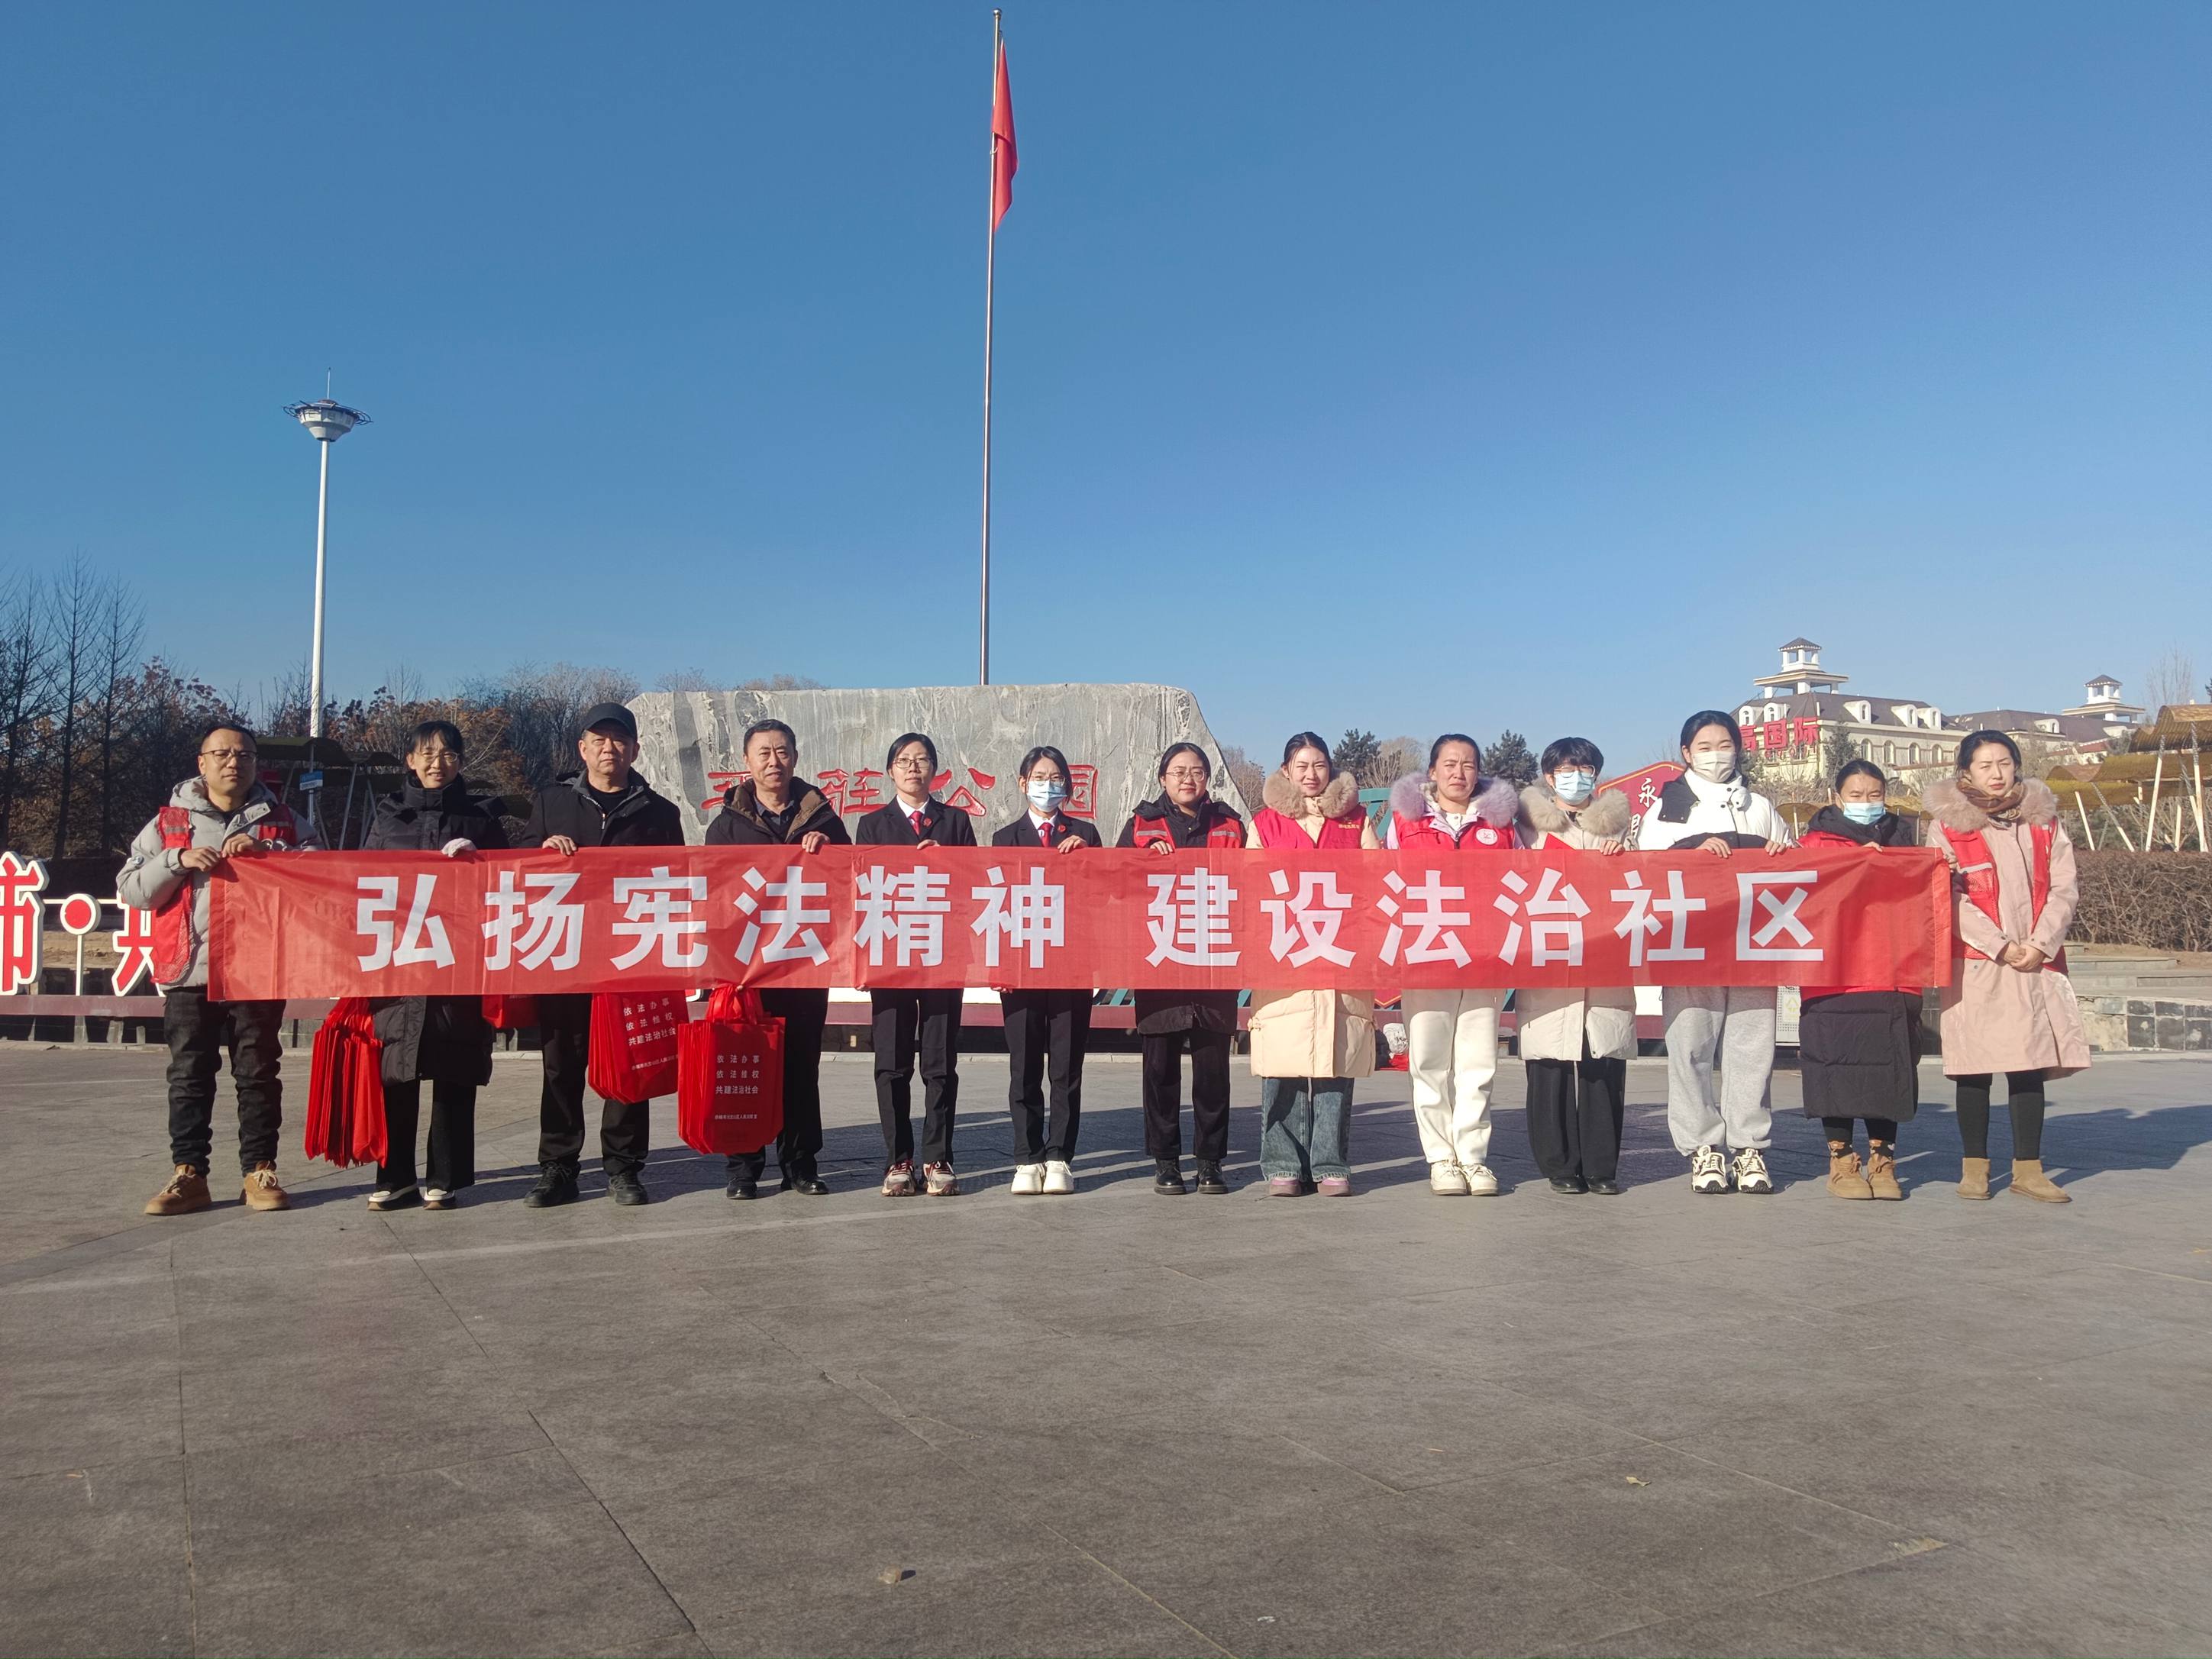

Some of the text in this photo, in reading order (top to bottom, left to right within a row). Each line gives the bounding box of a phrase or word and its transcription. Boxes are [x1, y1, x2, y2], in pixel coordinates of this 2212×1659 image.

[356, 865, 1824, 972] 弘扬宪法精神 建设法治社区
[623, 997, 670, 1016] 依法办事
[628, 1027, 677, 1046] 共建法治社会
[716, 1054, 760, 1064] 依法办事
[715, 1085, 759, 1095] 共建法治社会
